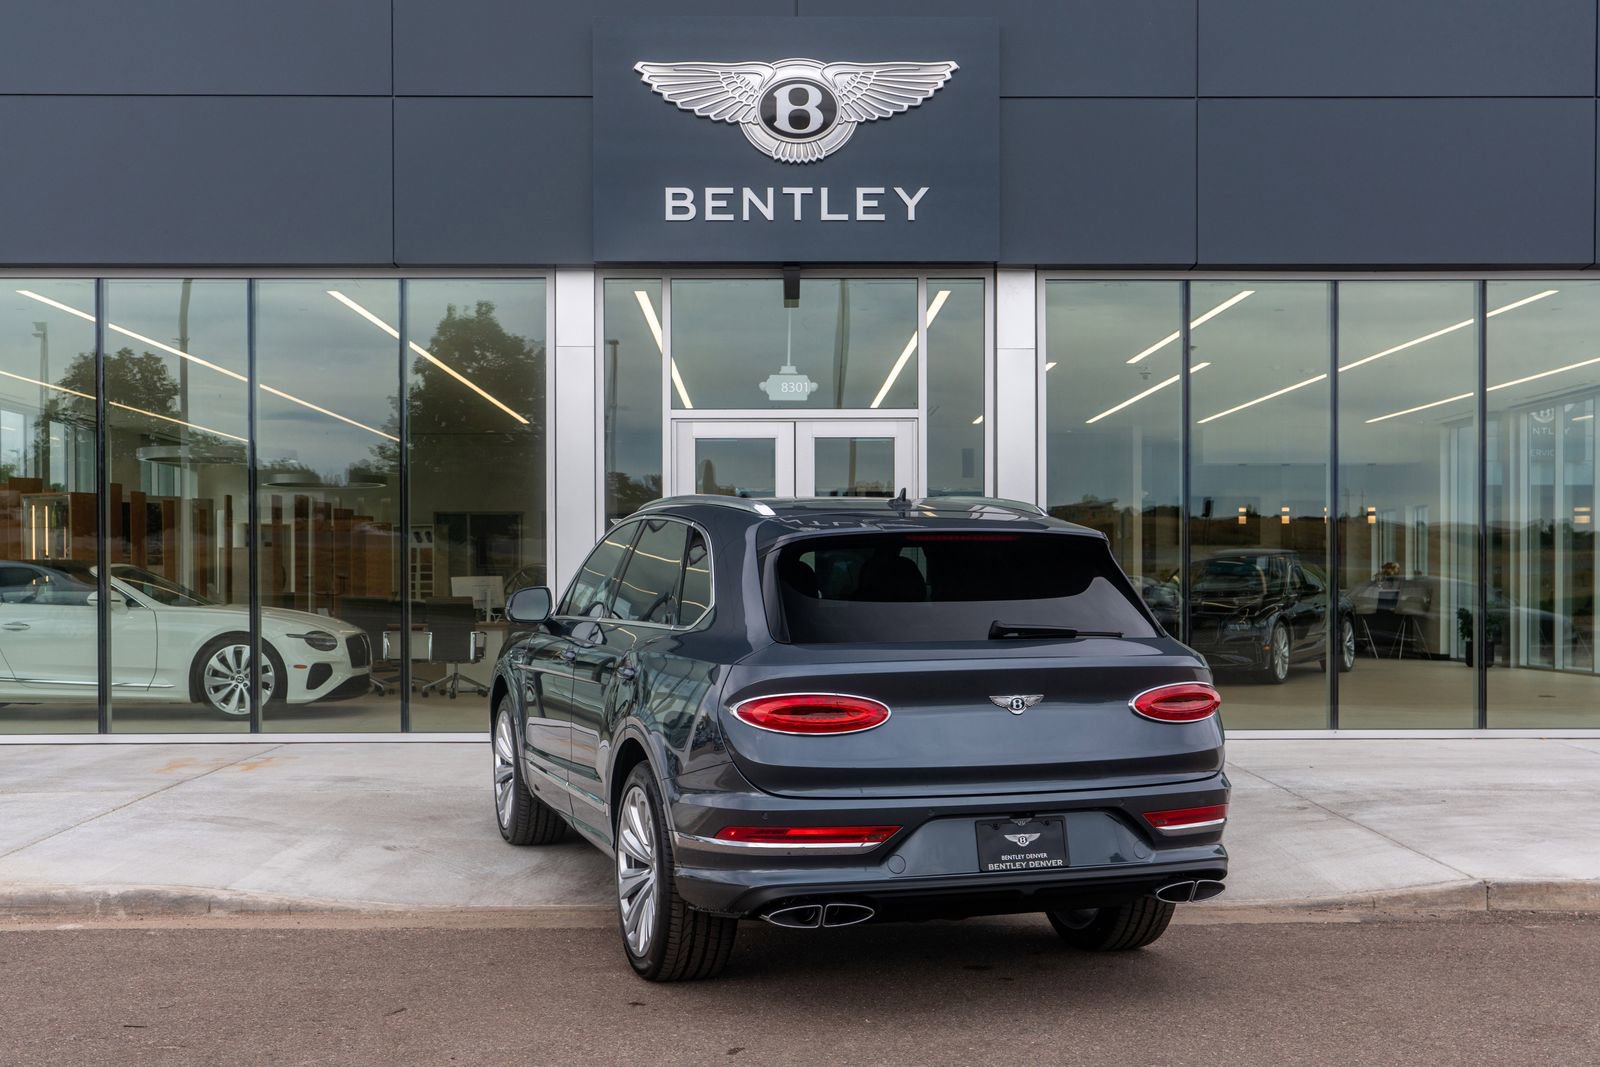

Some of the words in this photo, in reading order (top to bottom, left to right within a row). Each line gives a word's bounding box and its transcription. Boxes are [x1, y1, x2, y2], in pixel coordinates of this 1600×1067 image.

[773, 83, 823, 134] B
[664, 186, 930, 221] BENTLEY
[781, 382, 808, 393] 8301
[988, 861, 1028, 871] BENTLEY
[1029, 859, 1063, 868] DENVER
